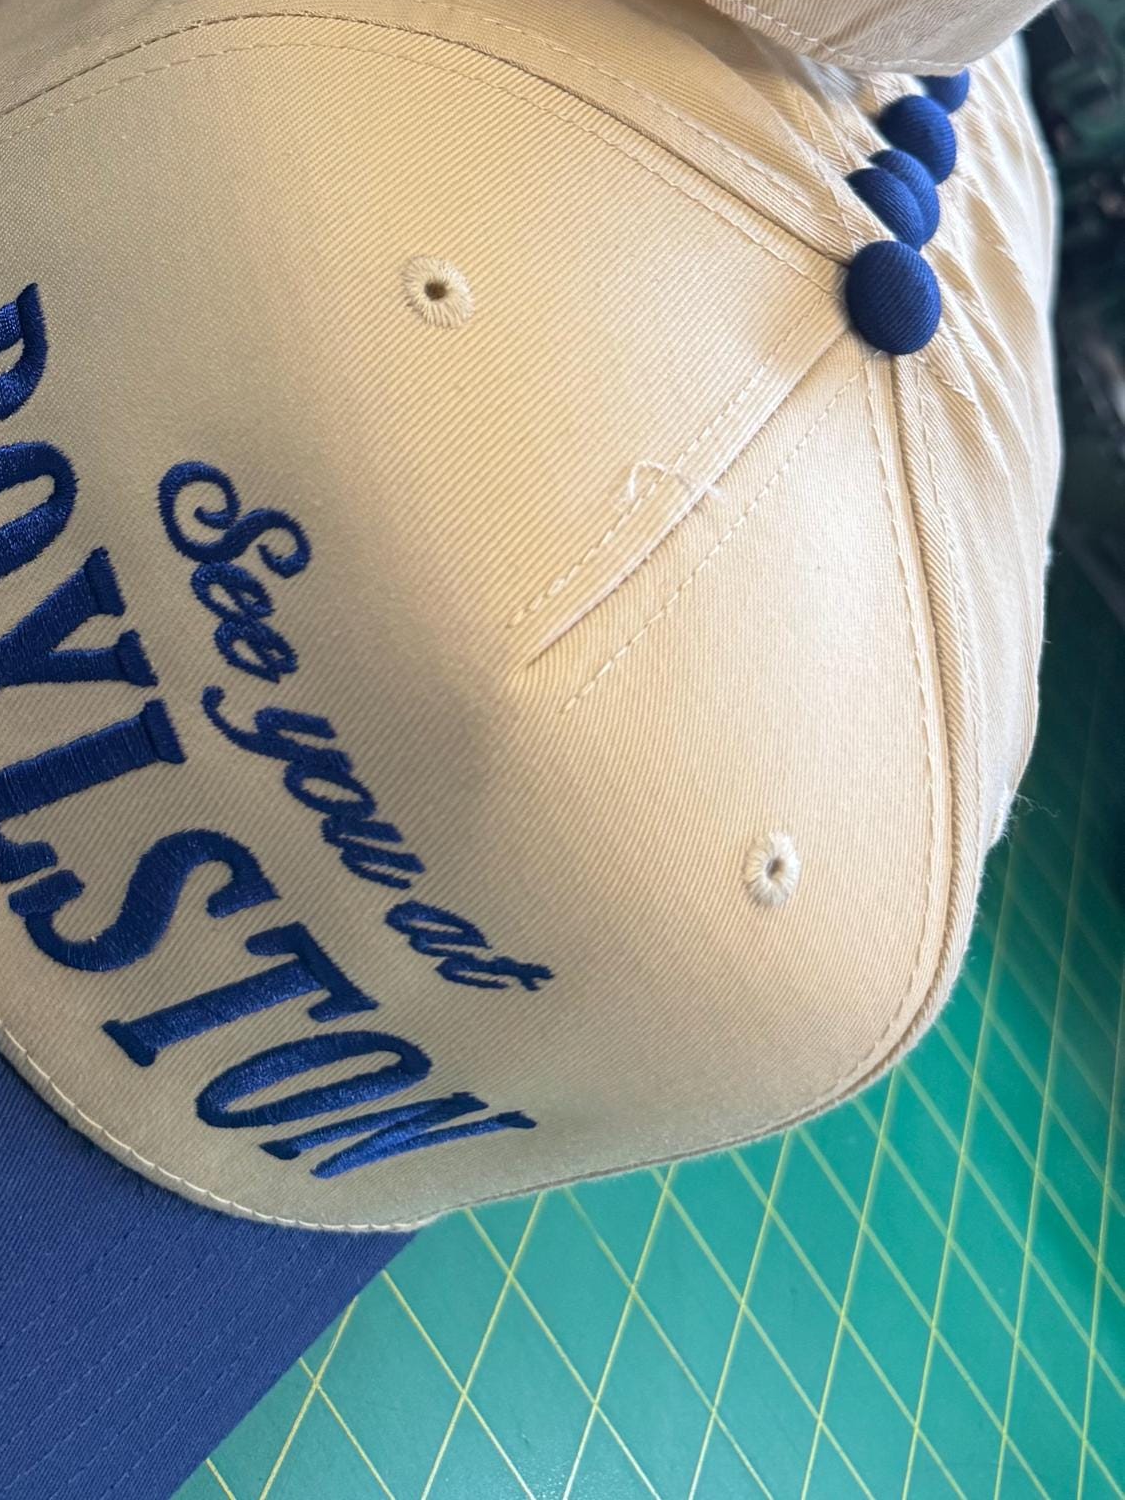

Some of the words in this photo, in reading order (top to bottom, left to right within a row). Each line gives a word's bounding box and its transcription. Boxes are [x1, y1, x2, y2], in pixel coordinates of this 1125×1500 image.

[157, 460, 311, 685] See
[200, 685, 426, 892] you
[384, 898, 555, 992] at
